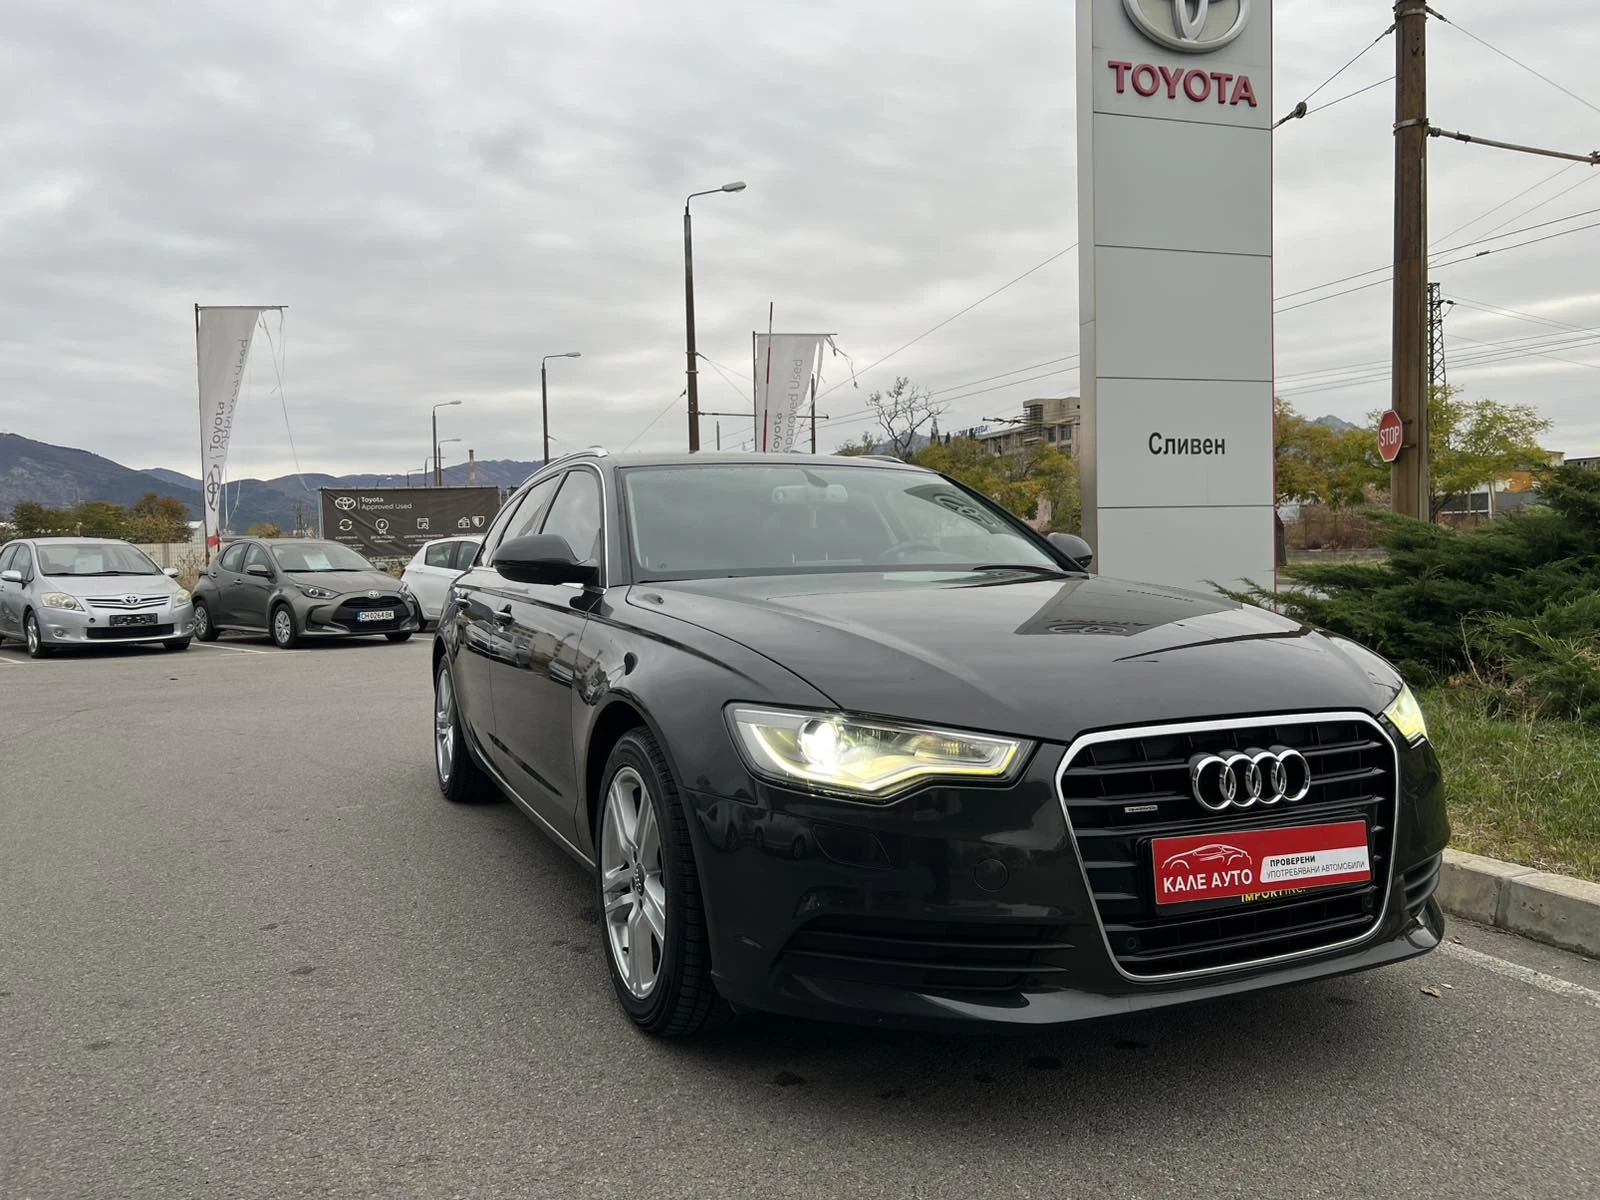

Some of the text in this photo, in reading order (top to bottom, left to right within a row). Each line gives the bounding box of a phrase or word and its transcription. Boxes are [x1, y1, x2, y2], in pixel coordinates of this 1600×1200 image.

[1107, 60, 1257, 107] TOYOTA
[789, 359, 803, 390] Used
[1148, 431, 1226, 455] Сливен
[1380, 426, 1399, 447] STOP
[361, 503, 394, 511] Approved
[1266, 860, 1365, 879] УПОТРЕБЯВАНИ АВТОМОБИЛИ
[1270, 855, 1316, 867] ПРОВЕРЕНИ
[1163, 868, 1253, 893] КАЛЕ АУТО
